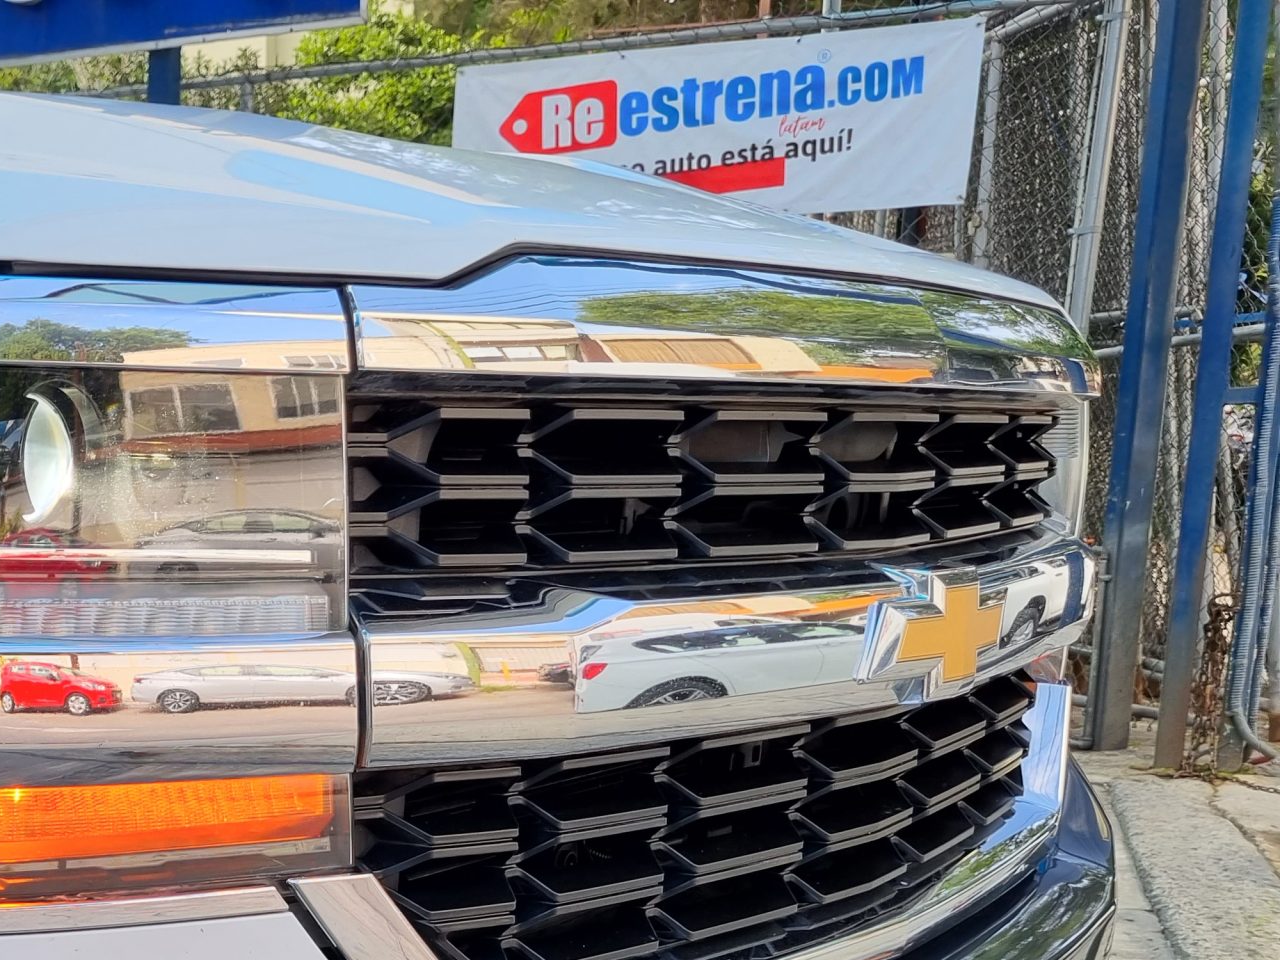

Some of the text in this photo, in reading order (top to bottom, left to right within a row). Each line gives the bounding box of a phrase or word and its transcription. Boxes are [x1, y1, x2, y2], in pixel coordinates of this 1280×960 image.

[653, 152, 712, 176] auto
[720, 143, 774, 168] está
[785, 128, 853, 166] aquí!
